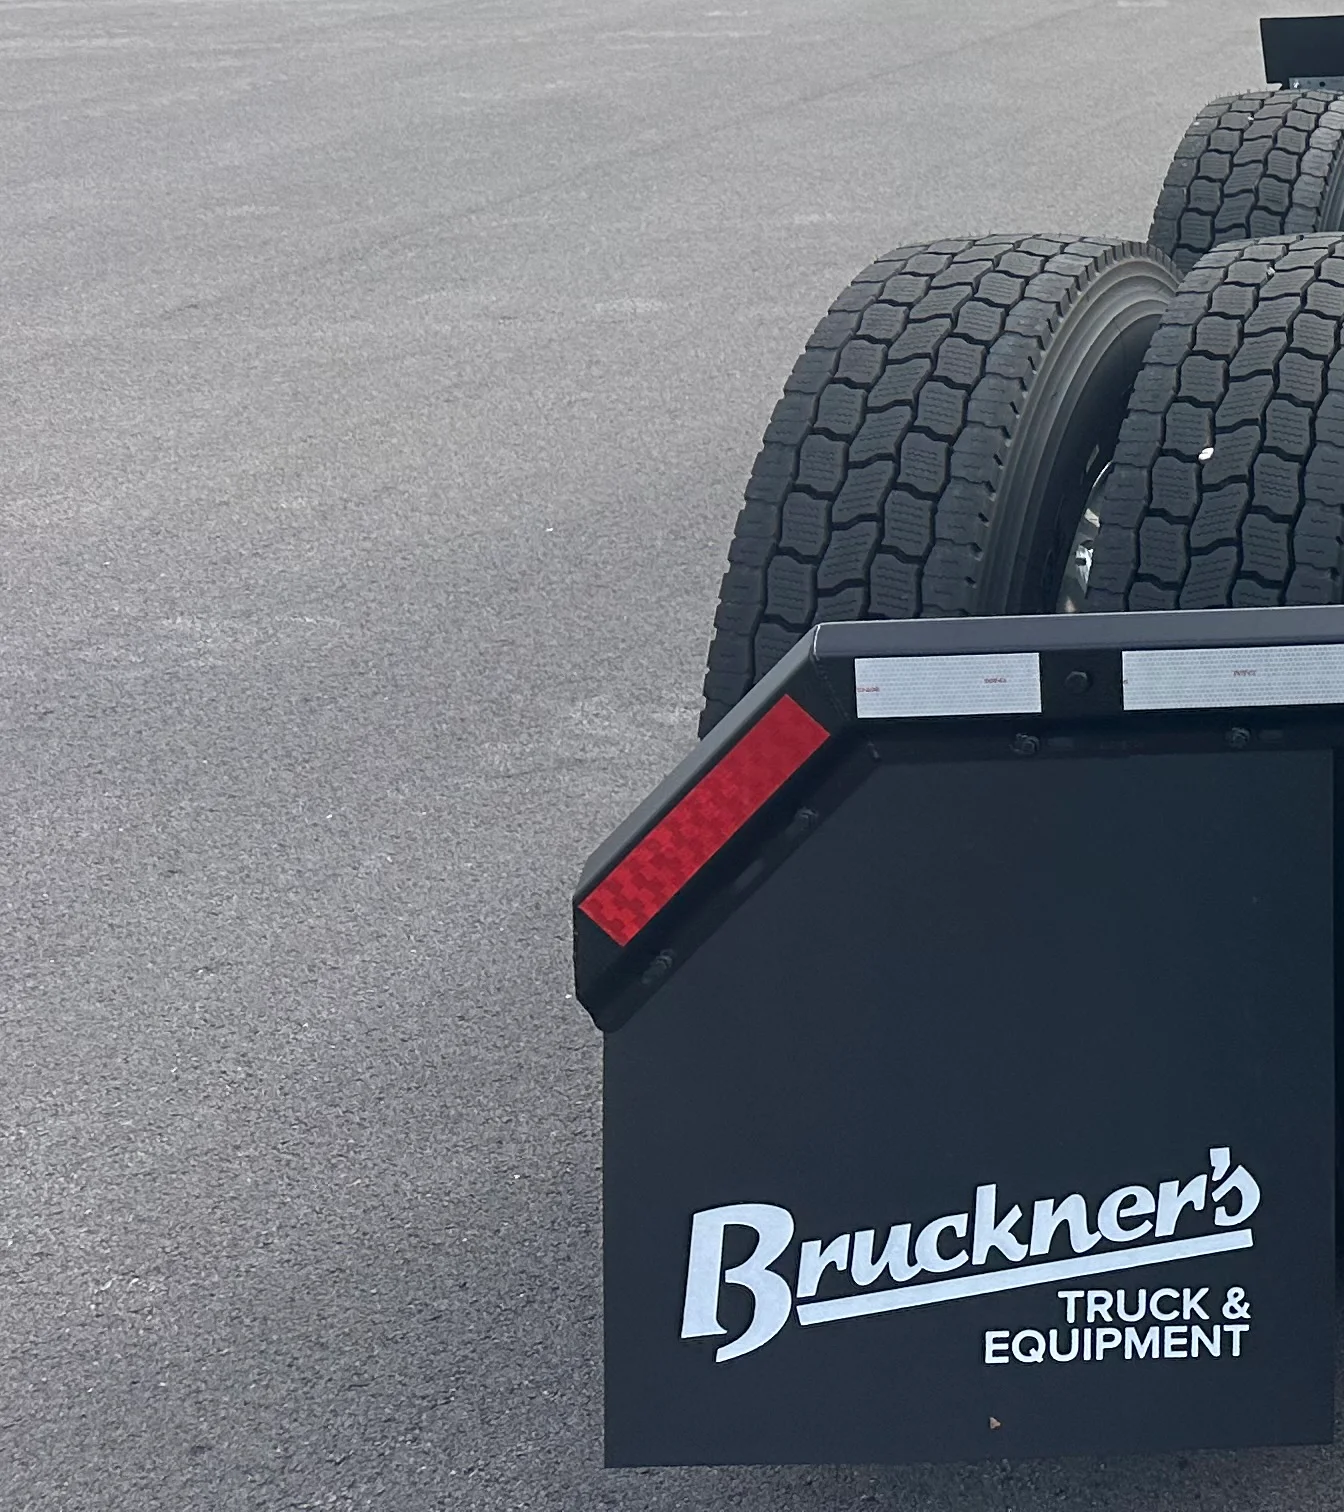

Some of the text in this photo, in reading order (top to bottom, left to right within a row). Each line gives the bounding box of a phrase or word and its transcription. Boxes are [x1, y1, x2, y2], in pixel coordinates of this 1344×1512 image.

[680, 1146, 1261, 1364] Bruckner's
[1057, 1286, 1252, 1324] TRUCK &
[984, 1323, 1250, 1364] EQUIPMENT
